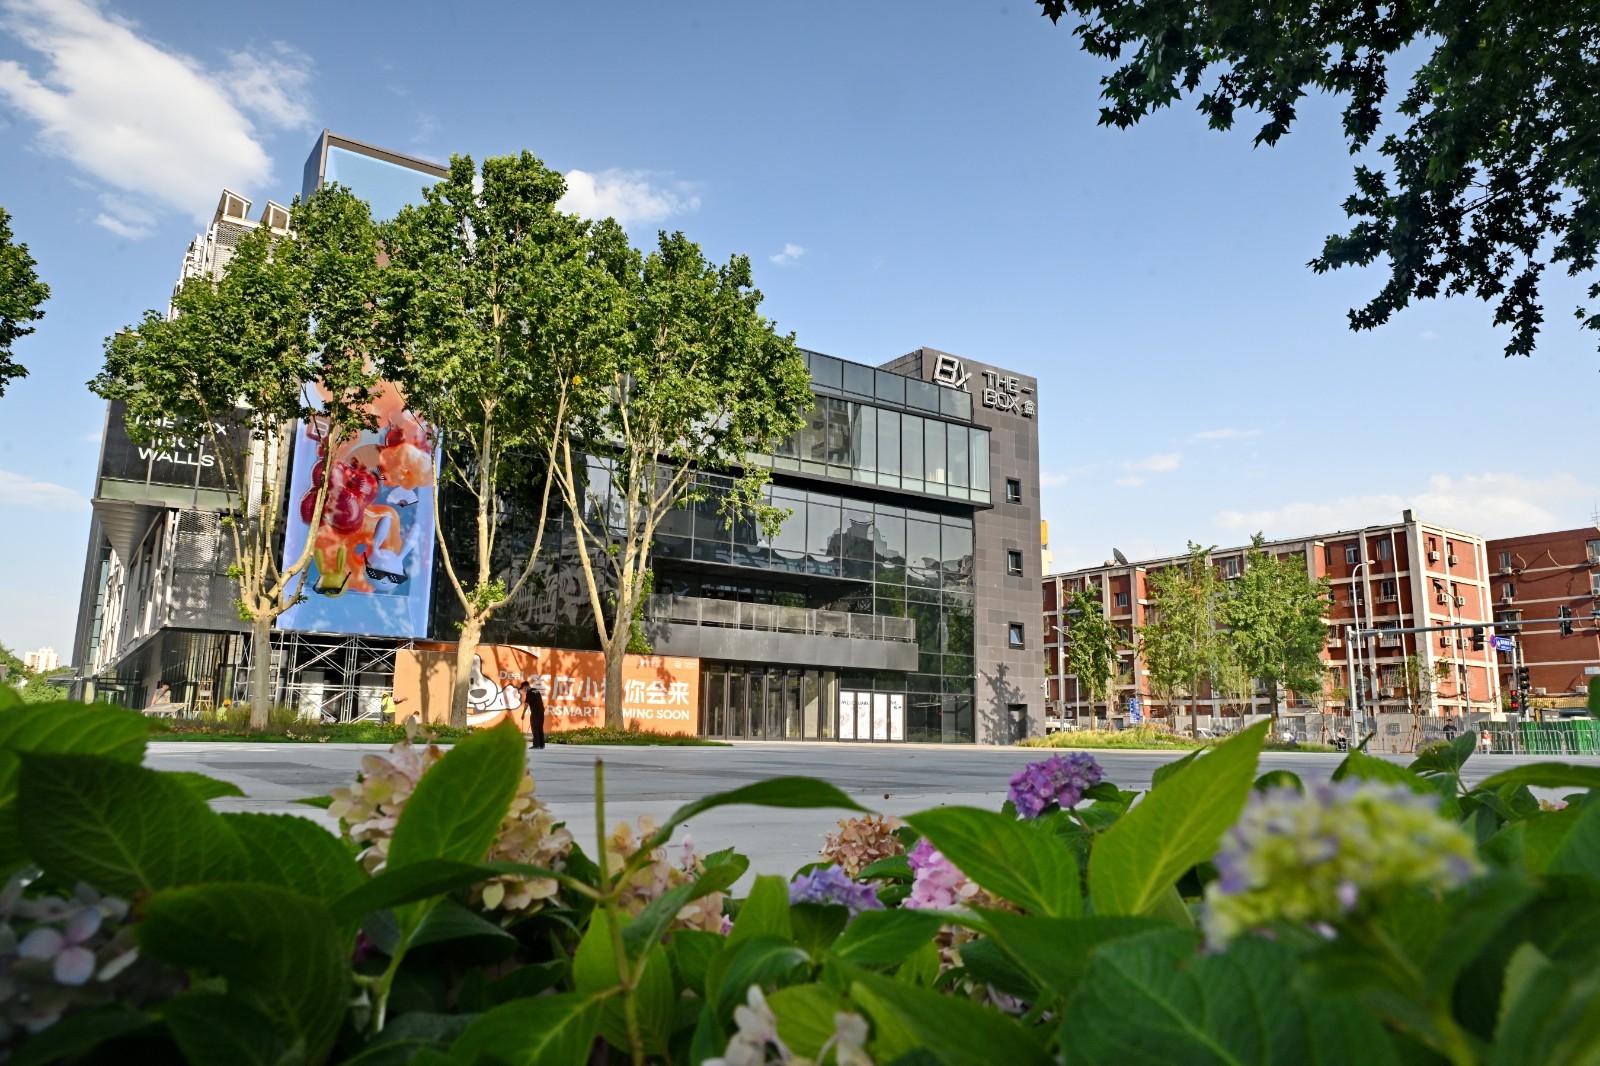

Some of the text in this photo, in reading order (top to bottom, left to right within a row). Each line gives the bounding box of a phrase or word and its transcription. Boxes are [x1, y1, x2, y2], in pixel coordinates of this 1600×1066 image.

[984, 370, 1020, 393] THE
[984, 388, 1020, 412] BOX
[138, 447, 215, 467] WALLS
[500, 670, 525, 680] Deal
[527, 674, 690, 706] 答应小 你会来
[528, 704, 599, 717] RSMART
[622, 707, 690, 720] MING SOON
